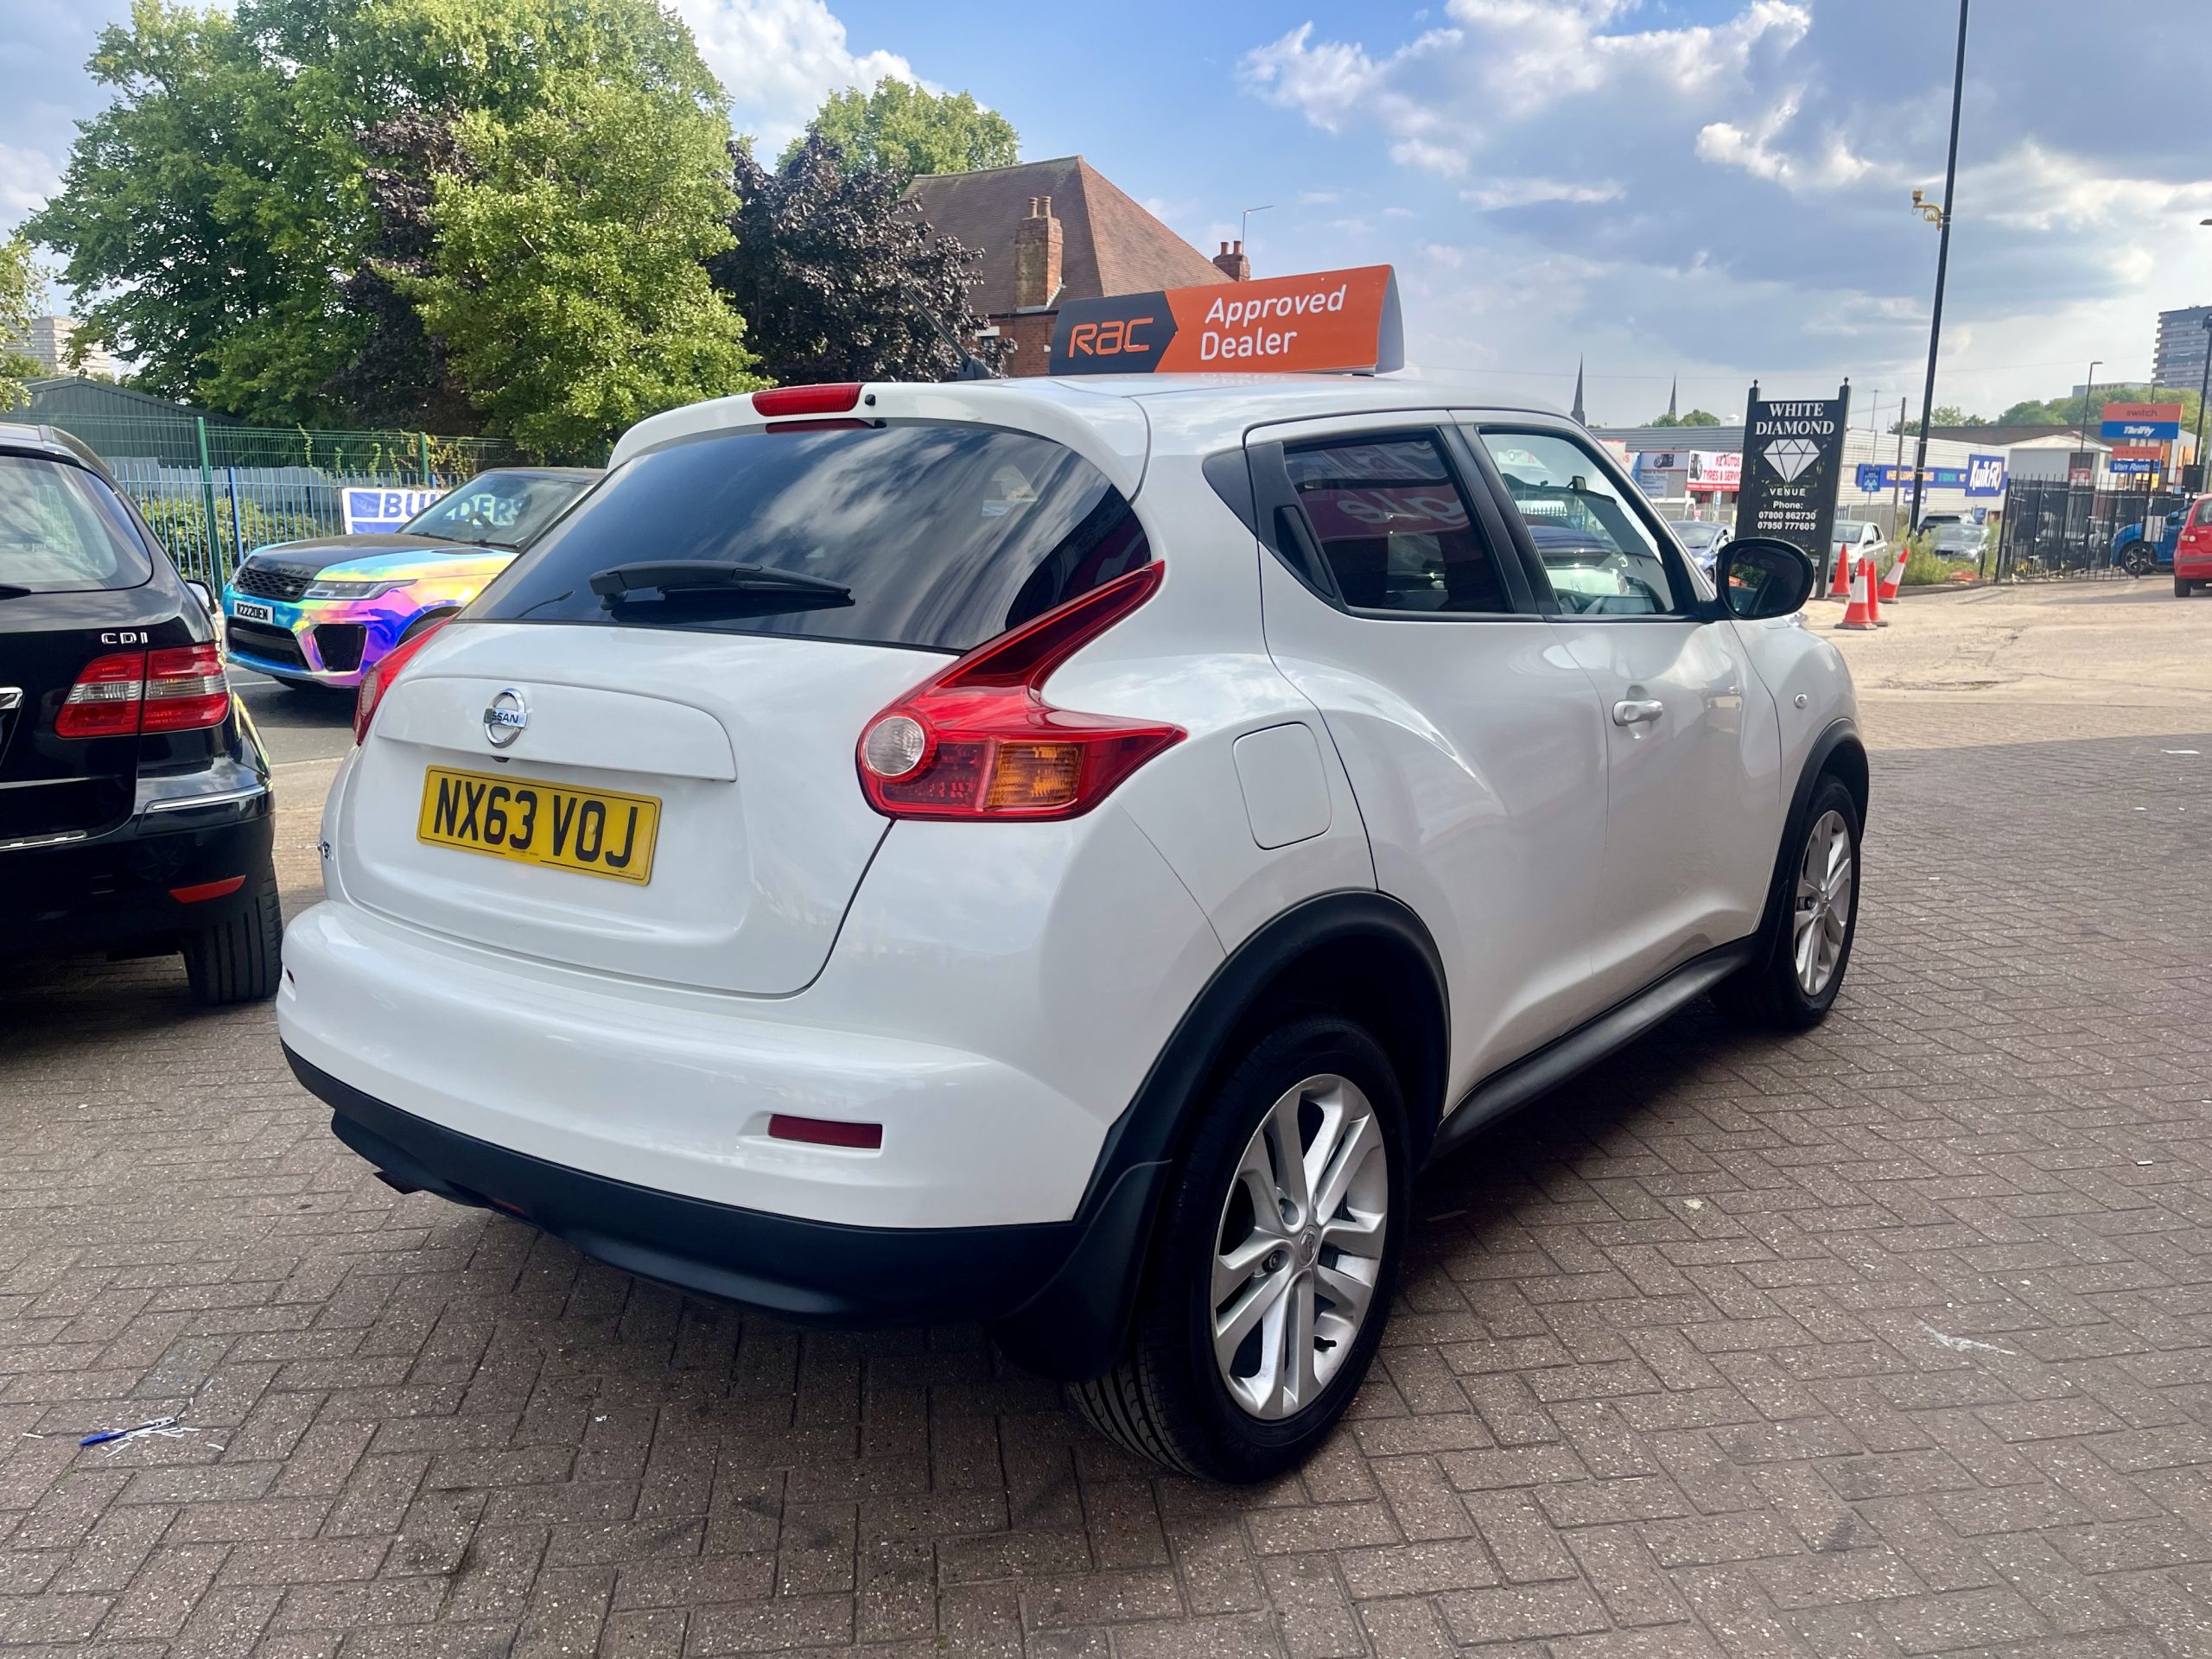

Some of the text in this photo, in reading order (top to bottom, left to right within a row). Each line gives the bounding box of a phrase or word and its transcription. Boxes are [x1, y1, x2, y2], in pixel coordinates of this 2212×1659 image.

[1205, 284, 1347, 329] Approved
[1200, 327, 1298, 361] Dealer
[1769, 403, 1825, 417] WHITE
[1756, 420, 1835, 435] DIAMOND
[2123, 425, 2156, 437] Thrifty
[1723, 455, 1740, 467] AUTOS
[2113, 462, 2151, 472] Van Rent
[1702, 469, 1719, 481] TYRES
[1770, 487, 1807, 497] VENUE
[1772, 500, 1803, 509] Phone:
[1758, 511, 1816, 520] 07800 862730
[1784, 522, 1815, 531] 777605
[101, 632, 149, 645] CDI
[433, 777, 639, 868] NX63 VOJ
